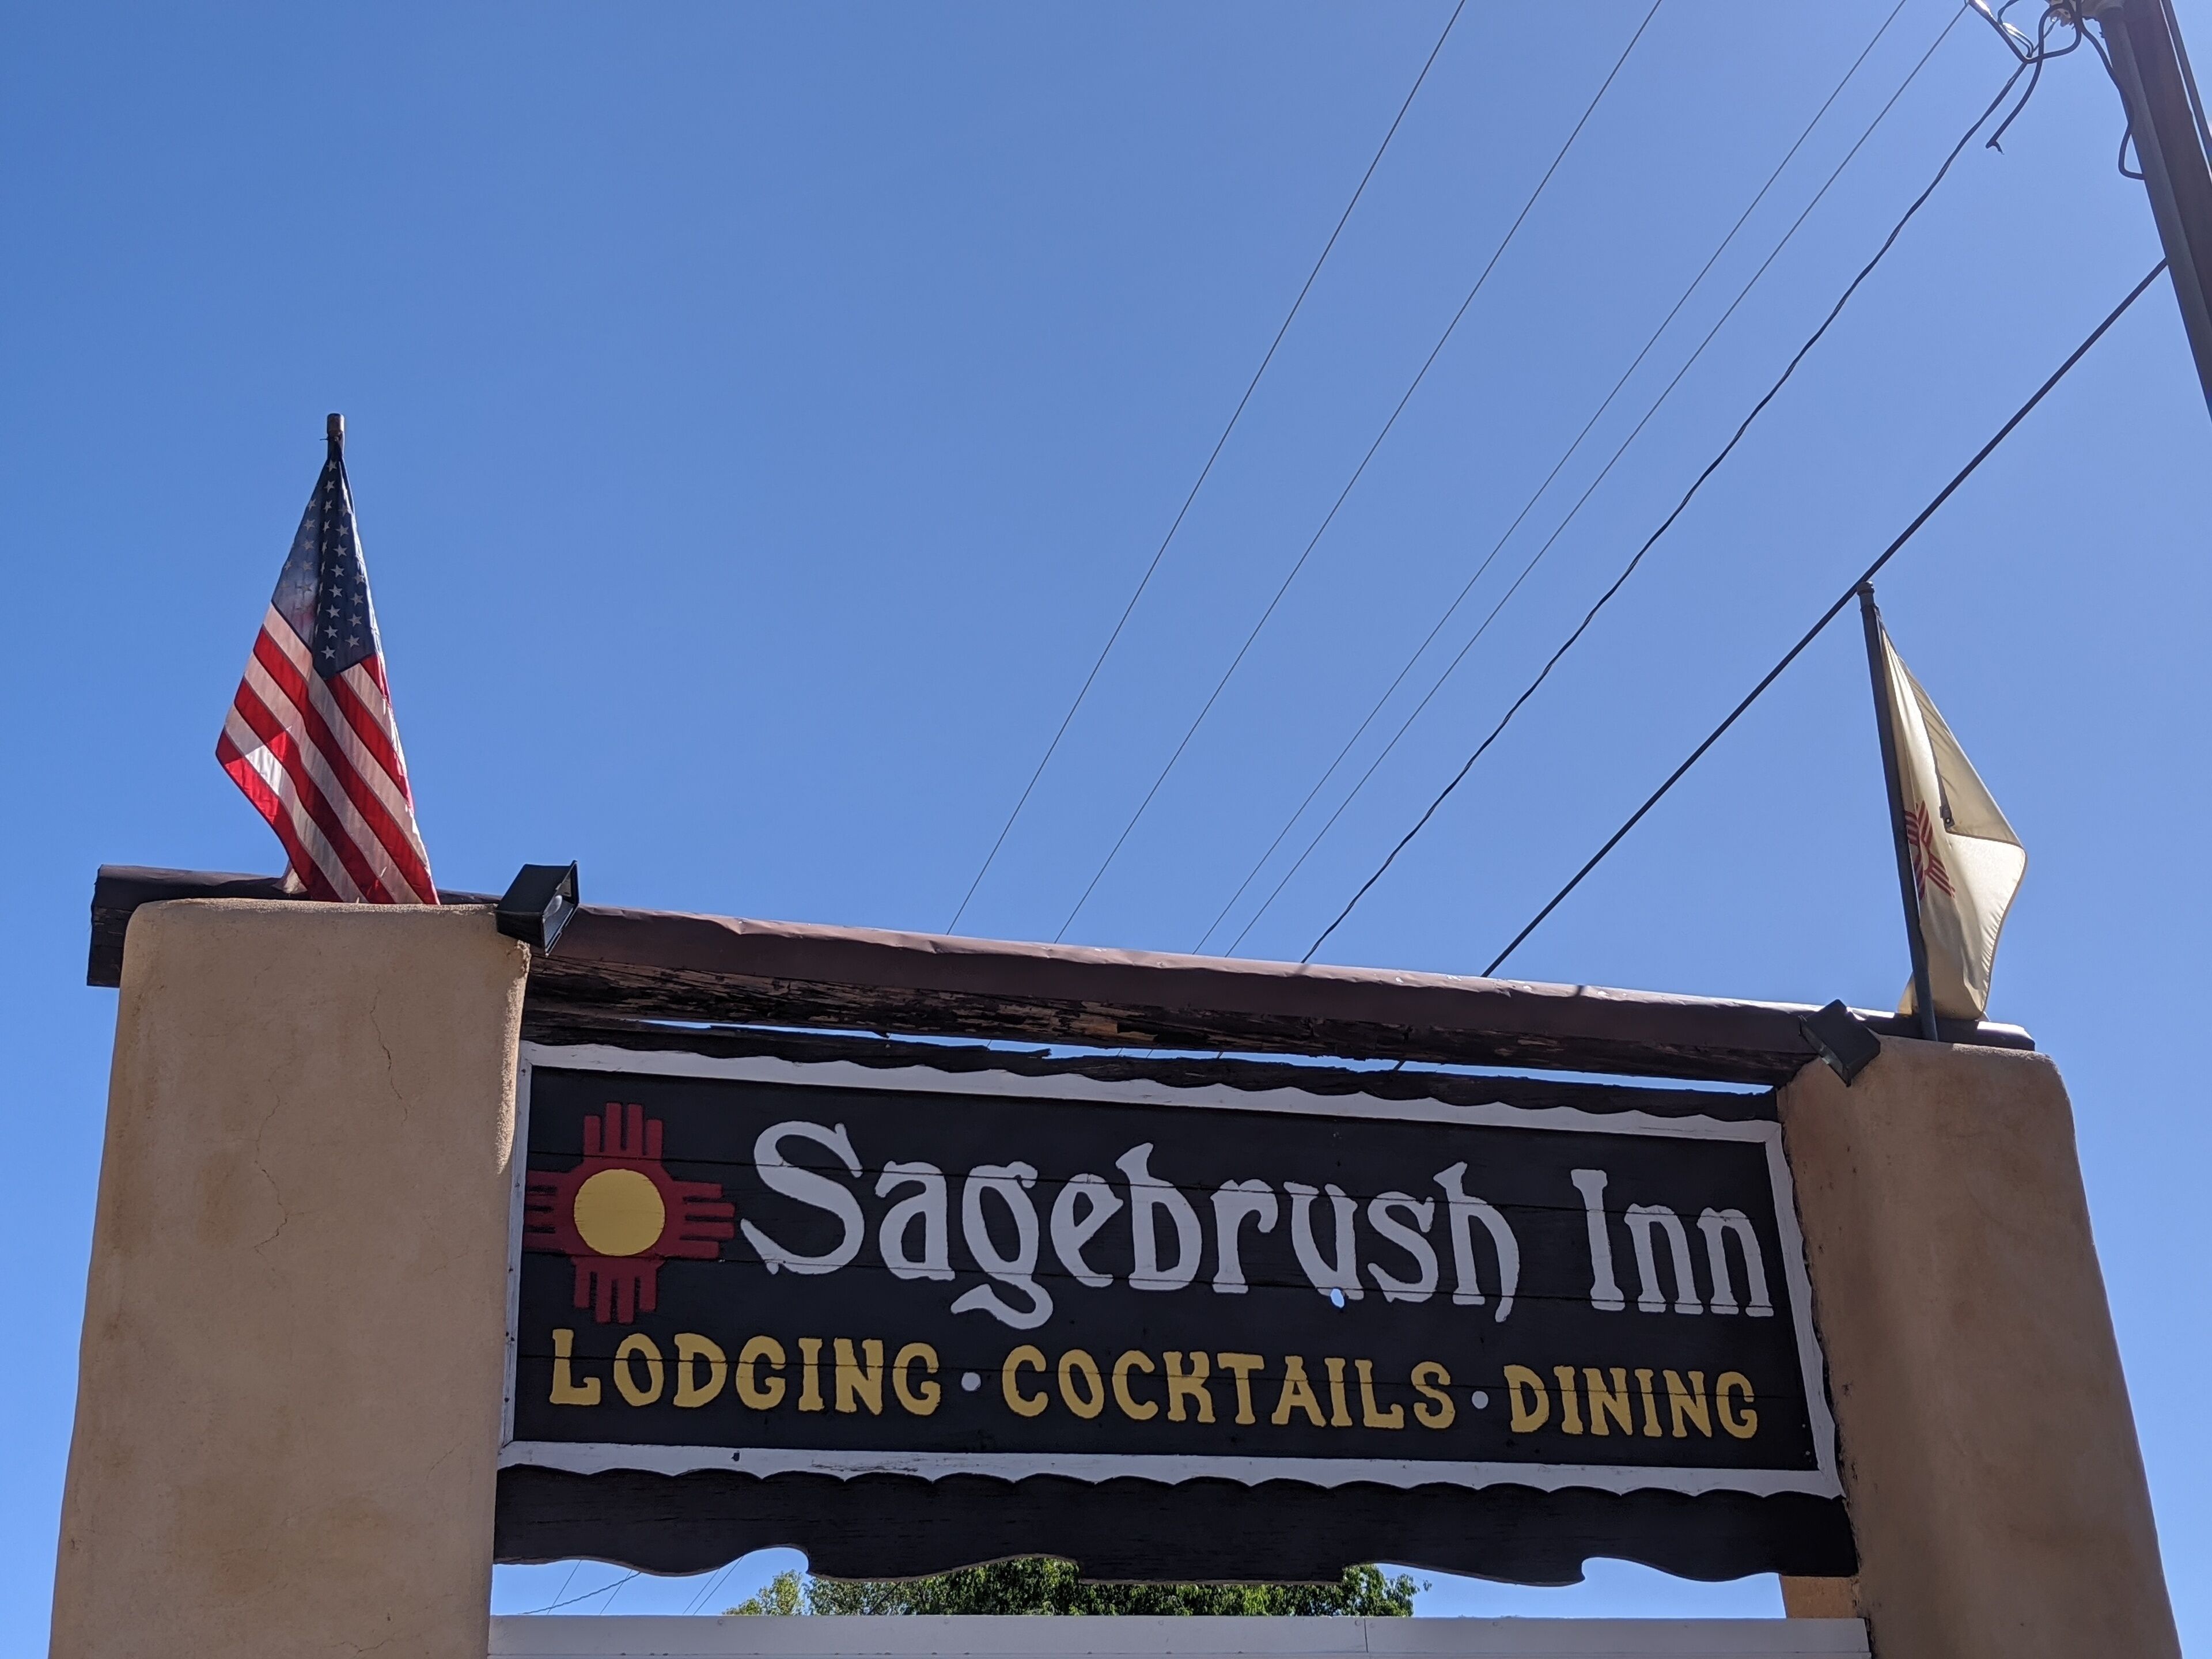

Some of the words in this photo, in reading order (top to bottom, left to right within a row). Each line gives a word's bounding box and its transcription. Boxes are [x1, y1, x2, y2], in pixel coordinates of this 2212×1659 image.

[741, 1120, 1520, 1330] Sagebrush
[1571, 1169, 1774, 1317] Inn
[549, 1329, 940, 1416] LODGING
[1002, 1344, 1455, 1430] COCKTAILS
[1503, 1365, 1758, 1439] DINING
